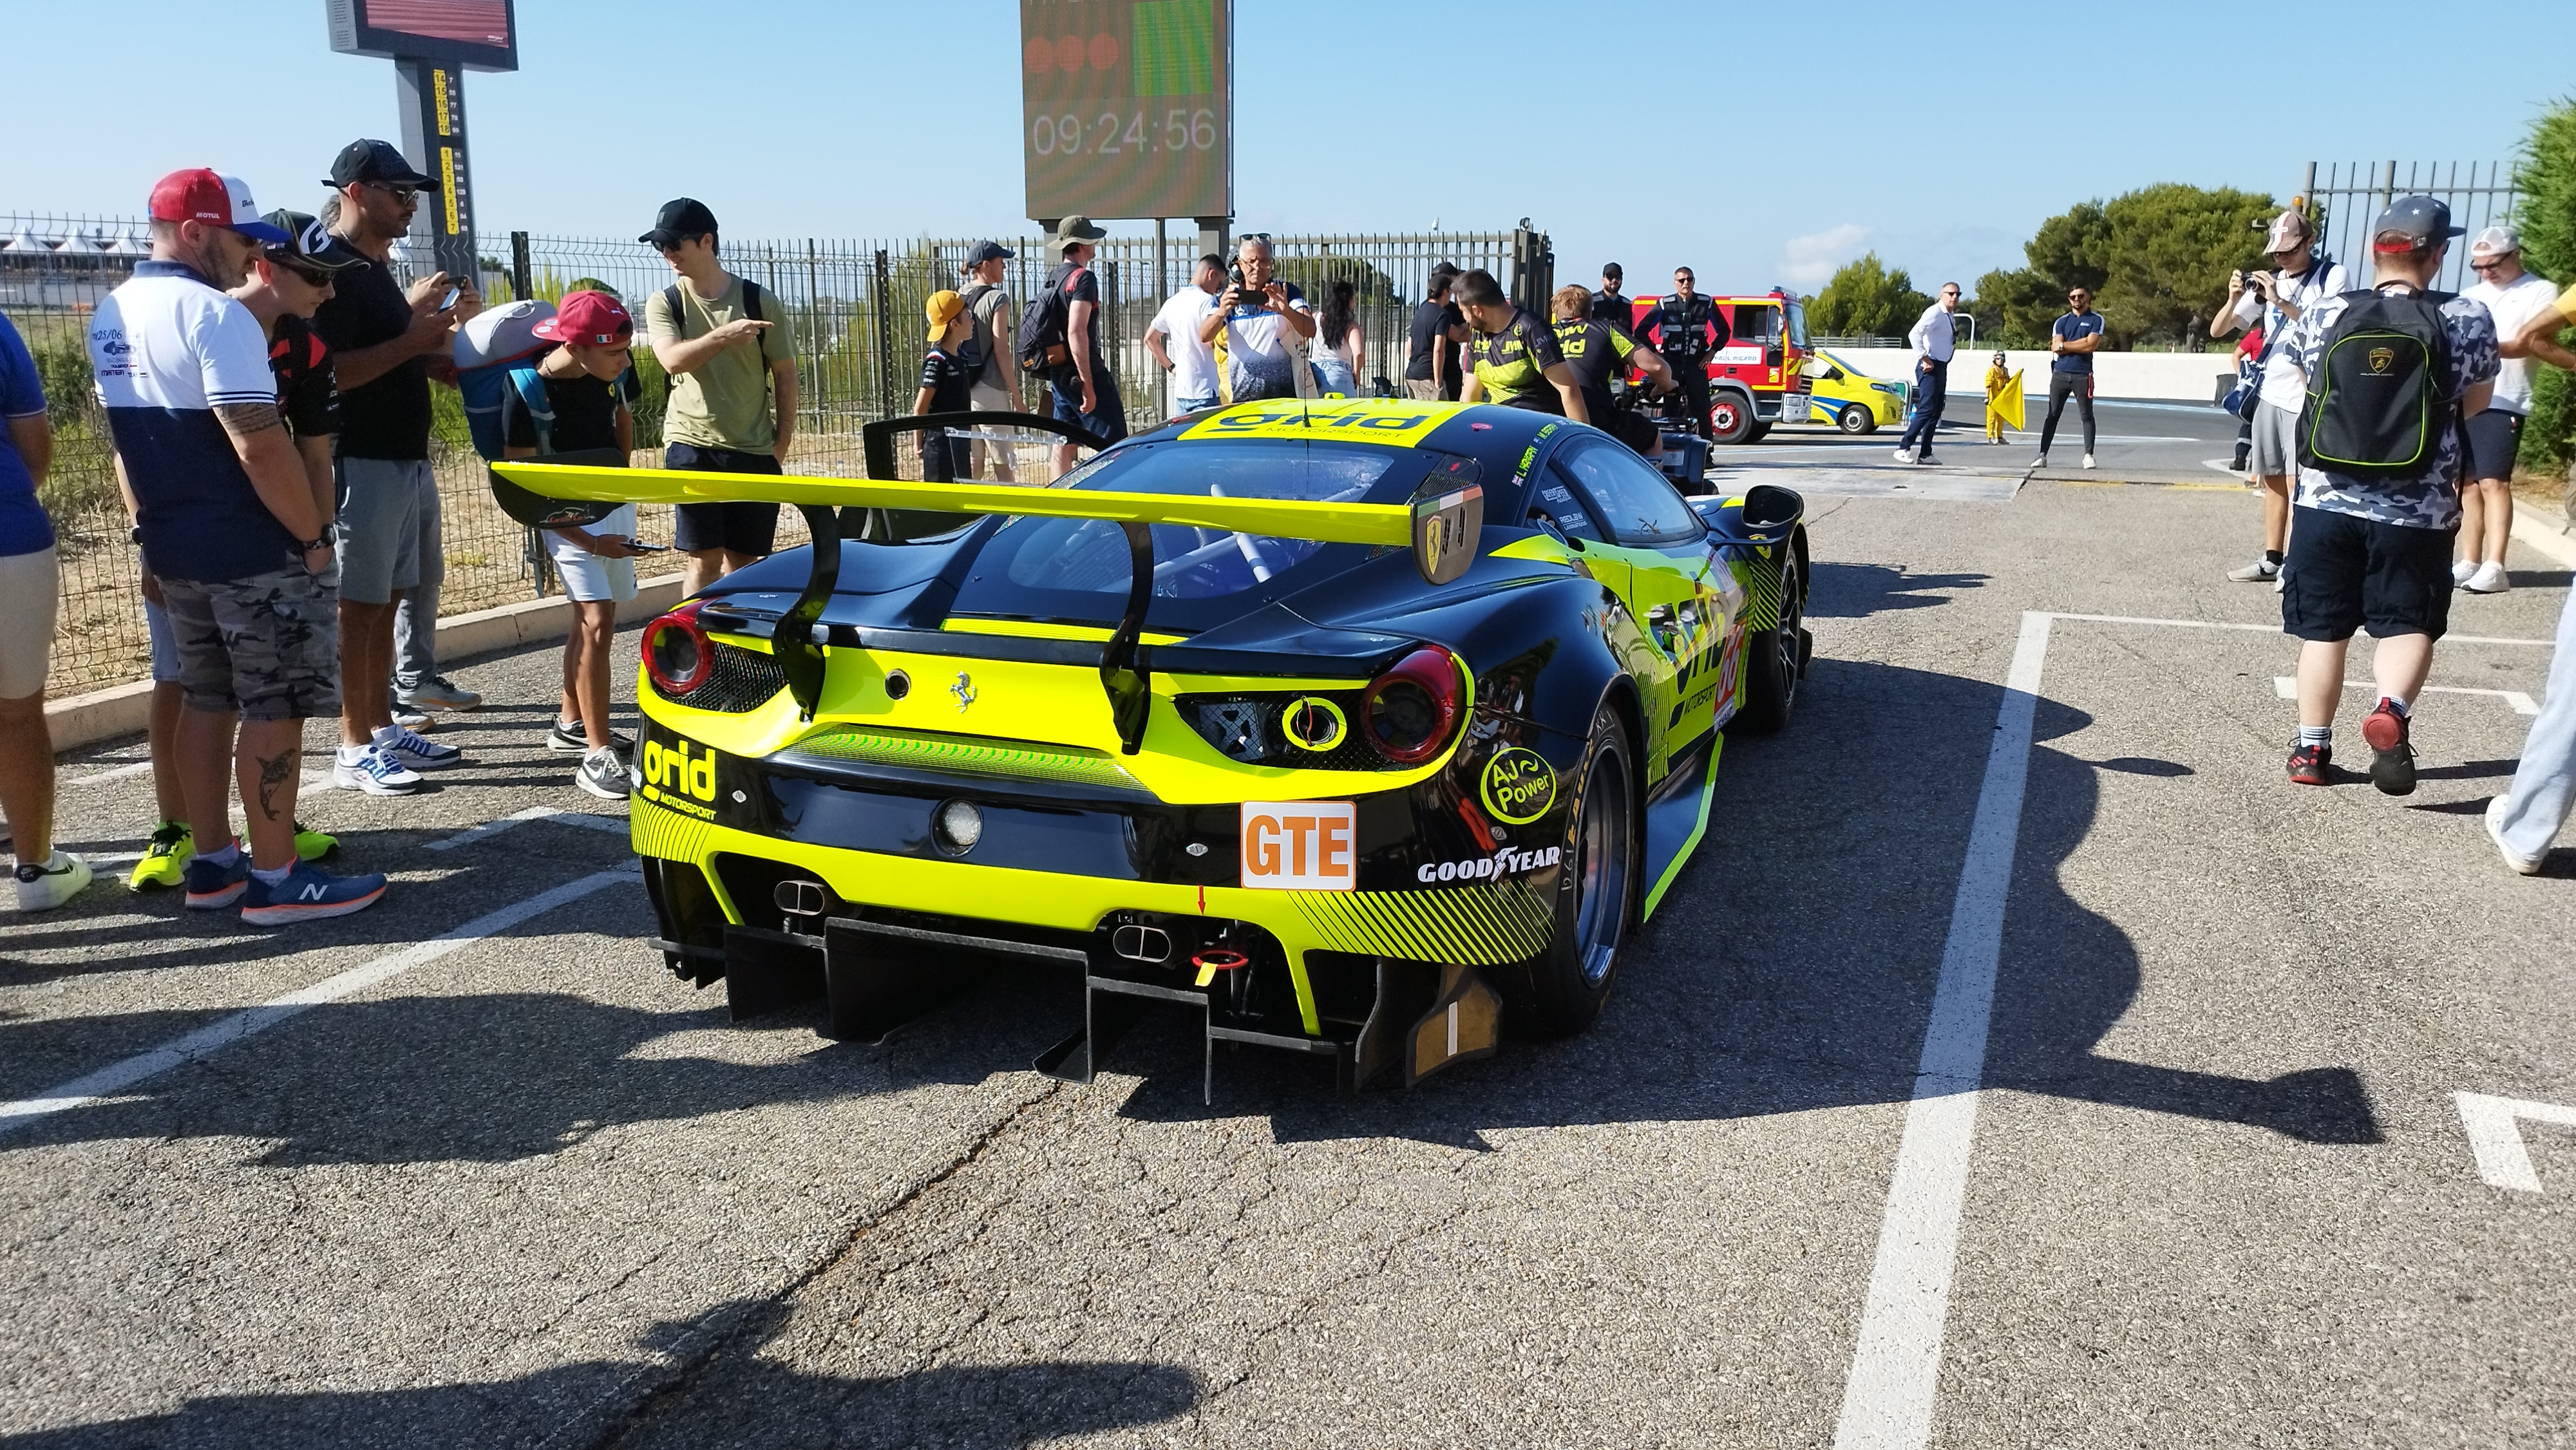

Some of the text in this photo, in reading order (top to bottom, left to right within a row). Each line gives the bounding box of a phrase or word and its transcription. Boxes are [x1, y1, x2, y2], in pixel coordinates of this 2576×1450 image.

[435, 74, 445, 82] 14
[437, 87, 447, 95] 15
[438, 100, 448, 108] 16
[439, 112, 448, 120] 17
[1034, 109, 1216, 155] 09:24:56
[1204, 412, 1431, 433] grid
[1265, 428, 1406, 438] MOTORSPORT
[1716, 623, 1746, 703] 66
[643, 740, 716, 802] grid
[1493, 758, 1519, 787] AJ
[659, 793, 717, 821] MOTORSPORT
[1497, 775, 1549, 813] Power
[1245, 814, 1349, 877] GTE
